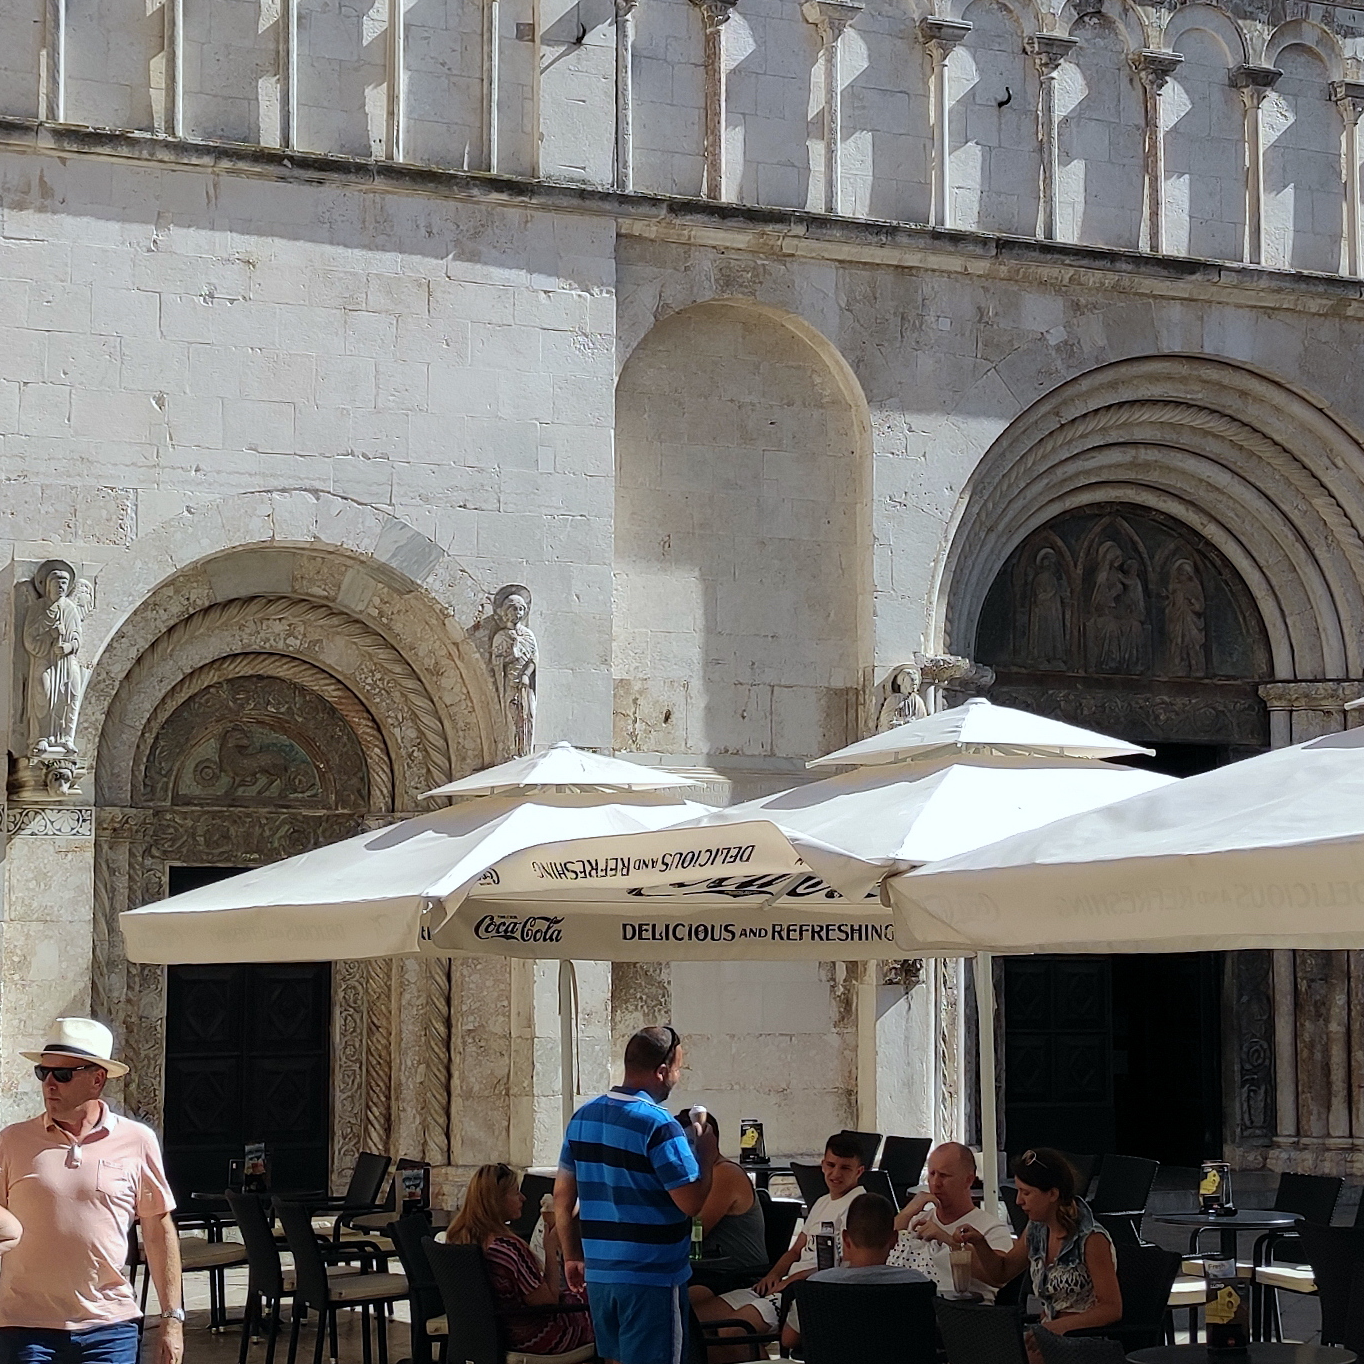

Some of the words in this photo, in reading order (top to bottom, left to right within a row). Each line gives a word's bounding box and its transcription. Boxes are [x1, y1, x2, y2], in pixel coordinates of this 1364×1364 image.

[531, 856, 631, 880] REFRESHING
[633, 857, 659, 872] AND
[658, 844, 756, 873] DELICIOUS
[621, 923, 736, 942] DELICIOUS
[738, 927, 769, 939] AND
[771, 923, 895, 942] REFRESHING
